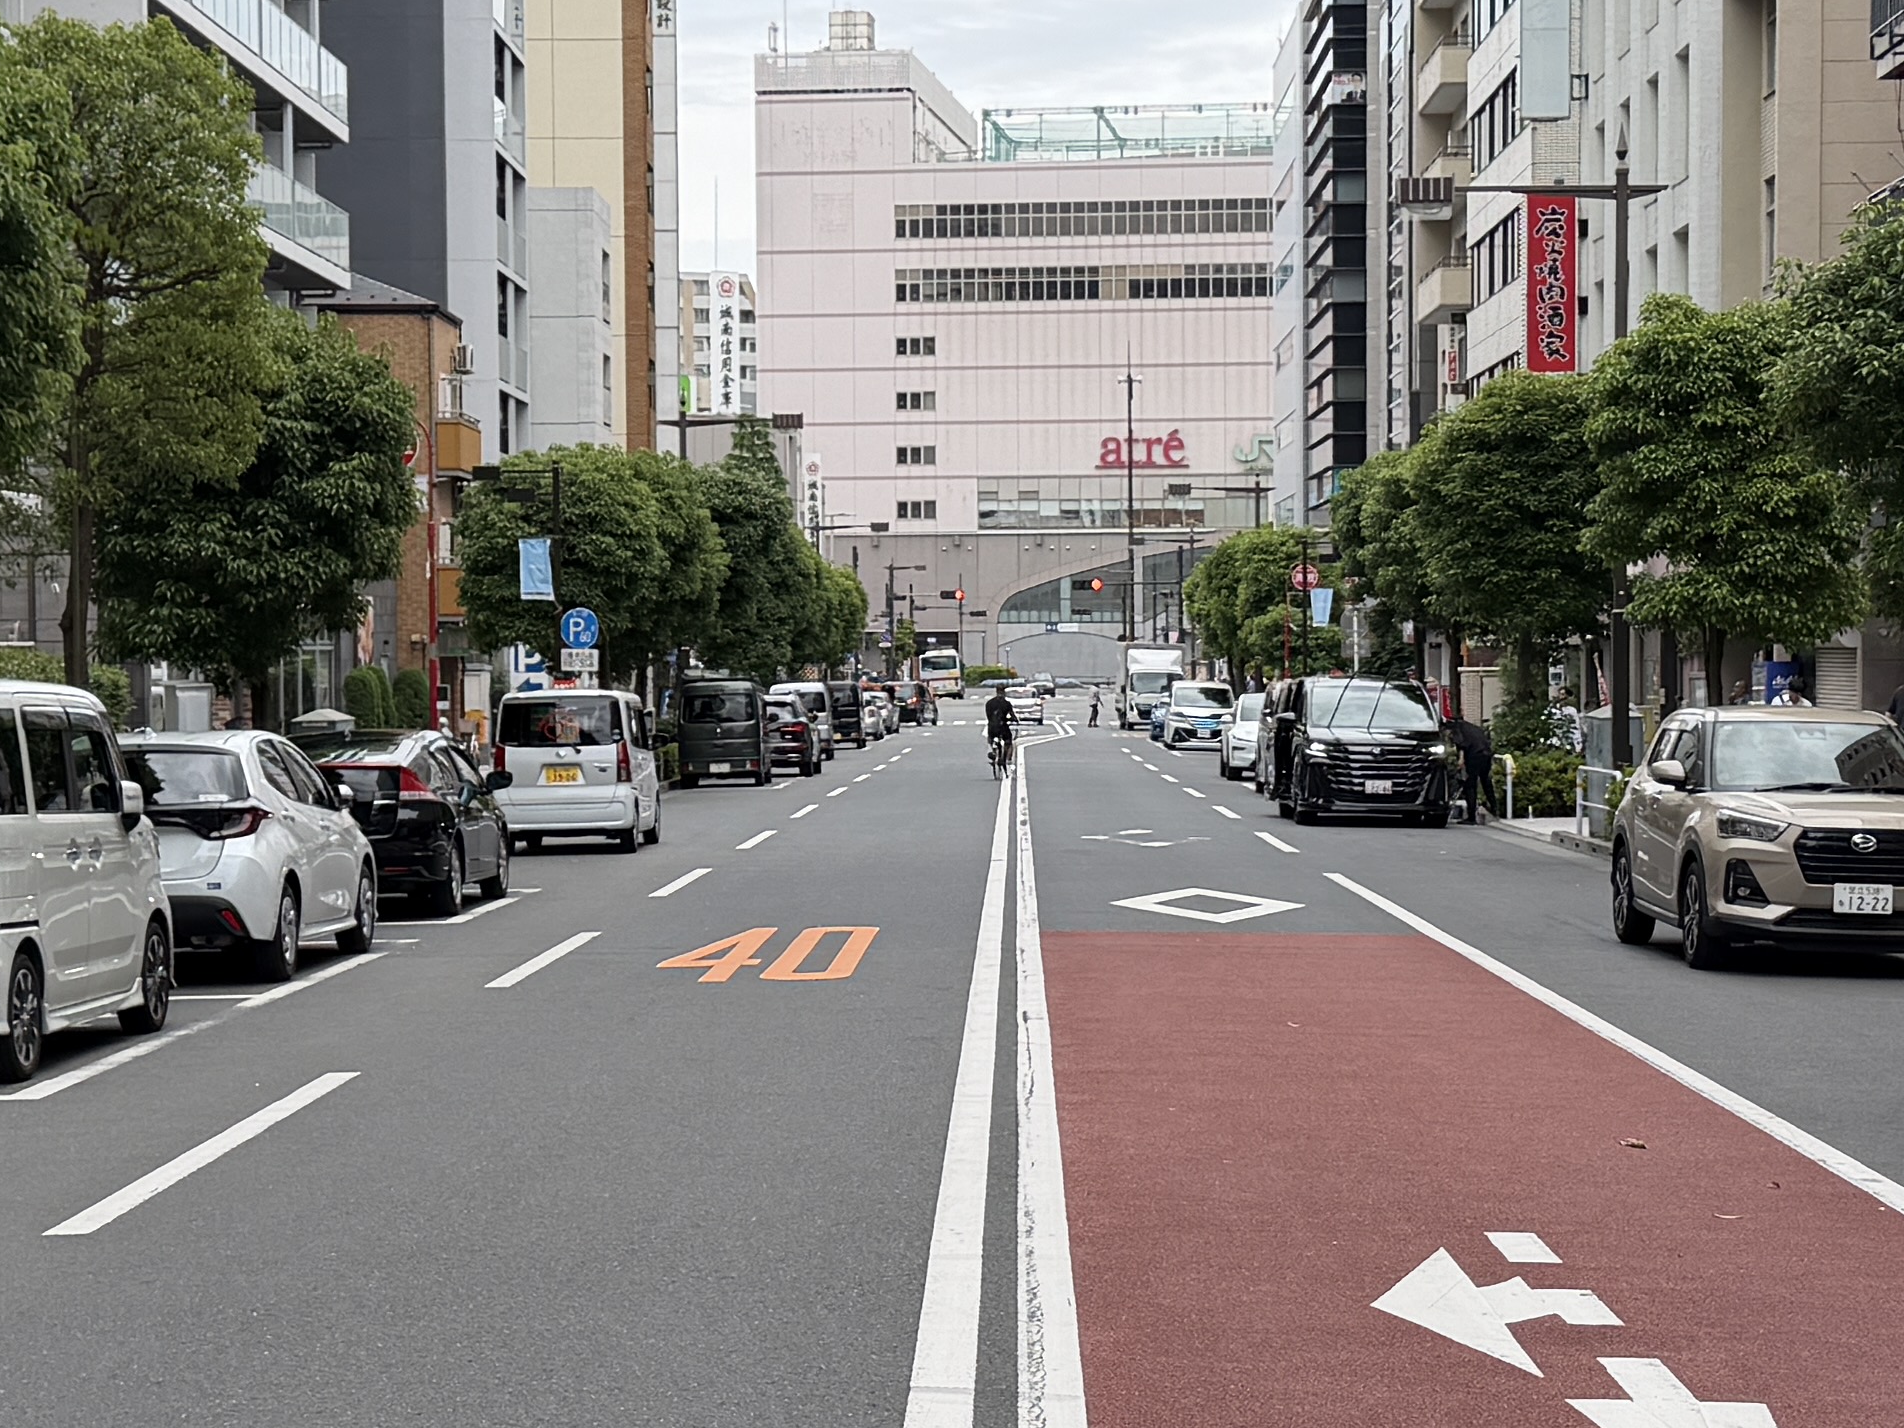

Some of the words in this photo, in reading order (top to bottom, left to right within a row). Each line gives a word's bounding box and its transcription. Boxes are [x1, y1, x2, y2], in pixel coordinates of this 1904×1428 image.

[569, 617, 585, 642] P
[1848, 896, 1890, 912] 12-22
[655, 926, 880, 983] 40
